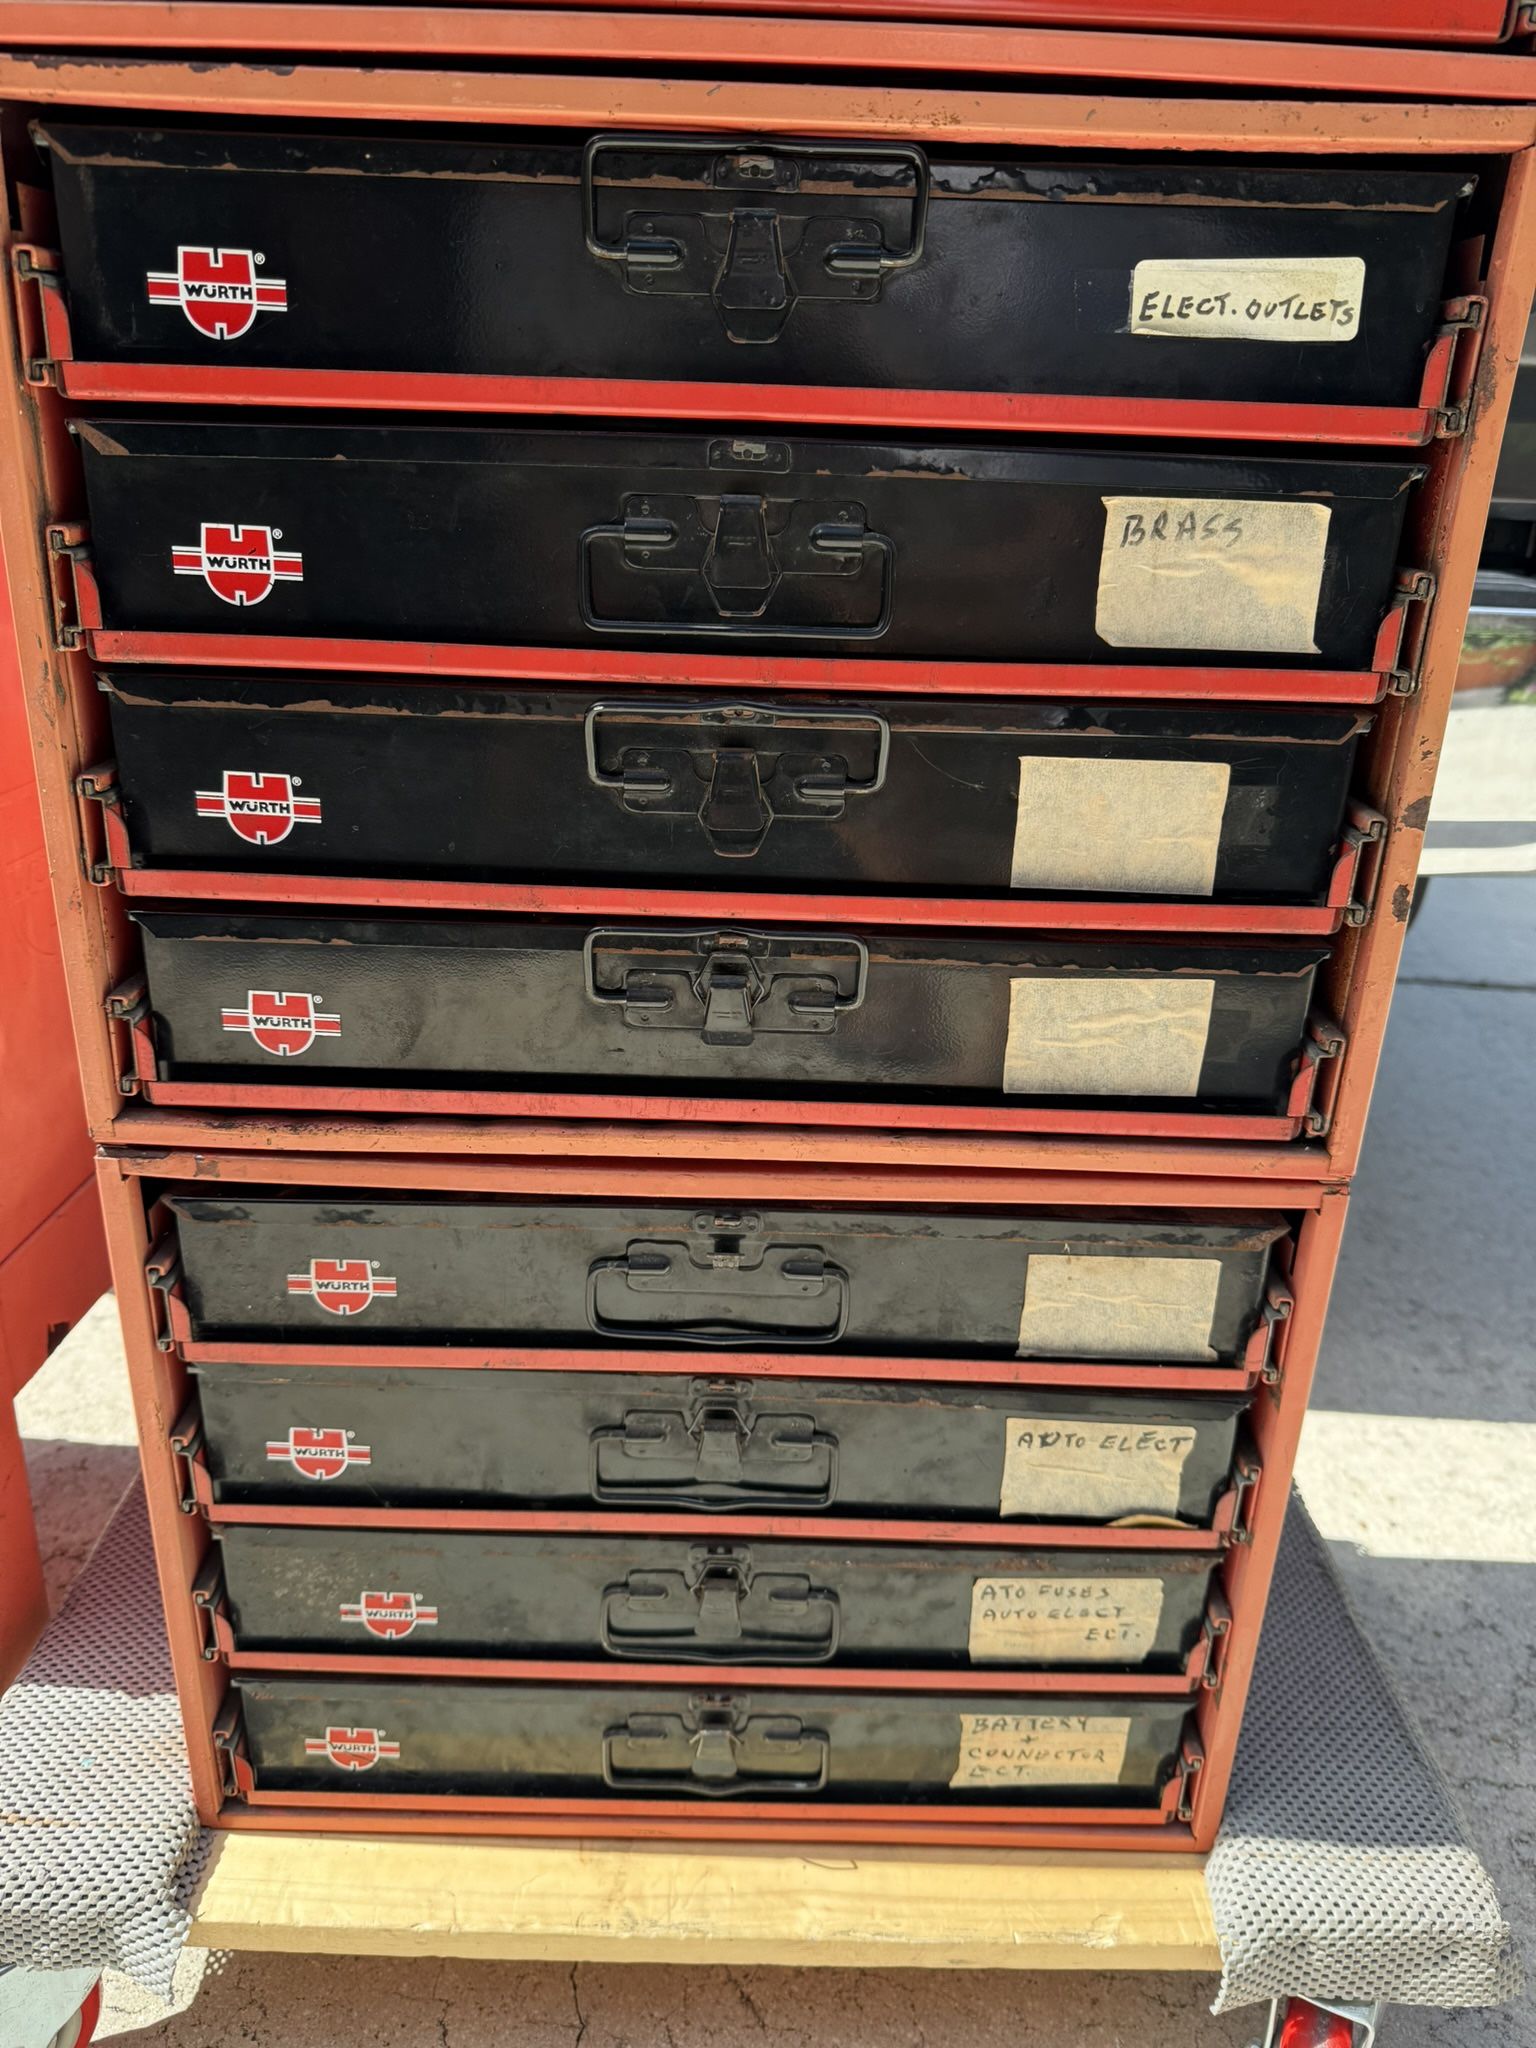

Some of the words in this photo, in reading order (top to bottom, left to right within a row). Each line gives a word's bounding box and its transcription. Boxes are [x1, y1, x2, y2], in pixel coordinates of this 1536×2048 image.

[184, 282, 253, 300] WÜRTH
[1139, 290, 1237, 321] ELECT.
[1245, 292, 1355, 326] OUTLETS
[1121, 514, 1244, 548] BRASS
[207, 556, 271, 570] WÜRTH
[230, 801, 290, 813] WÜRTH
[254, 1017, 311, 1028] WÜRTH
[317, 1281, 369, 1291] WÜRTH
[1018, 1430, 1086, 1451] AUTO
[1099, 1432, 1193, 1452] ELECT
[980, 1584, 1026, 1600] ATO
[971, 1716, 1091, 1733] BATTERY
